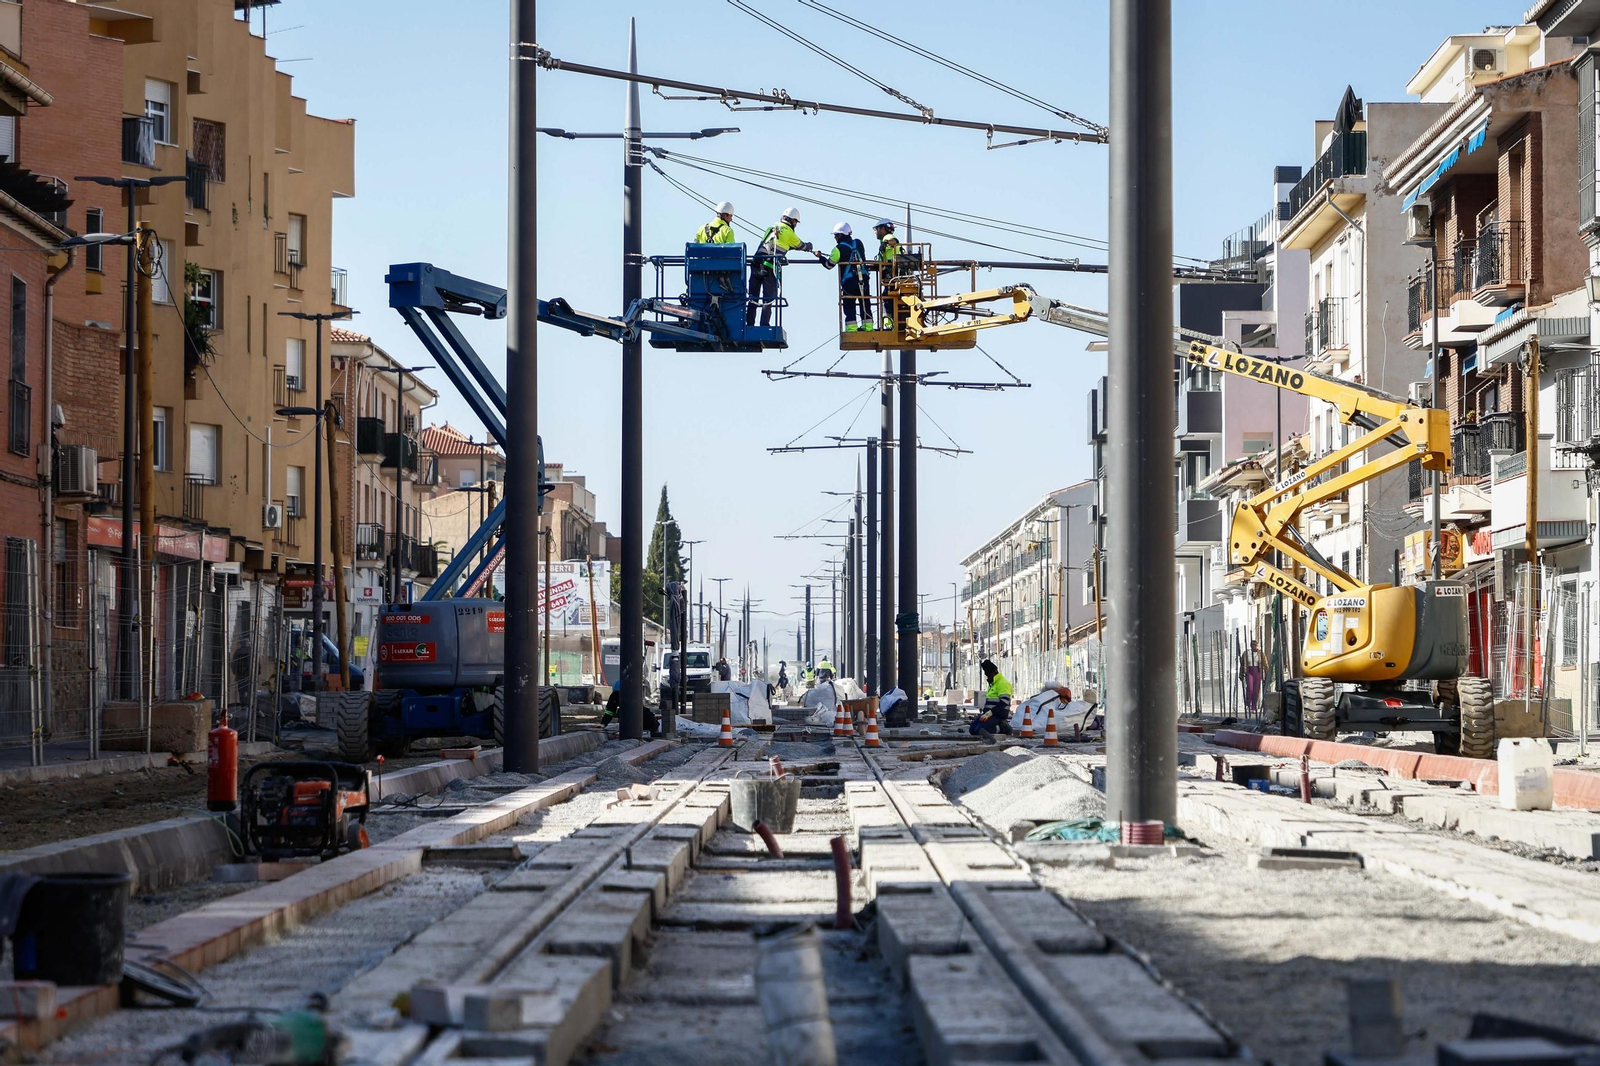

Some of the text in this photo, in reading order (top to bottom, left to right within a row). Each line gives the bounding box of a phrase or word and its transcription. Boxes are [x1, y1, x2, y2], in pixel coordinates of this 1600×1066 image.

[1224, 354, 1304, 389] LOZANO
[1280, 471, 1306, 488] LOZANO
[1269, 572, 1316, 606] LOZANO
[458, 606, 483, 615] 2219
[551, 599, 564, 608] 649
